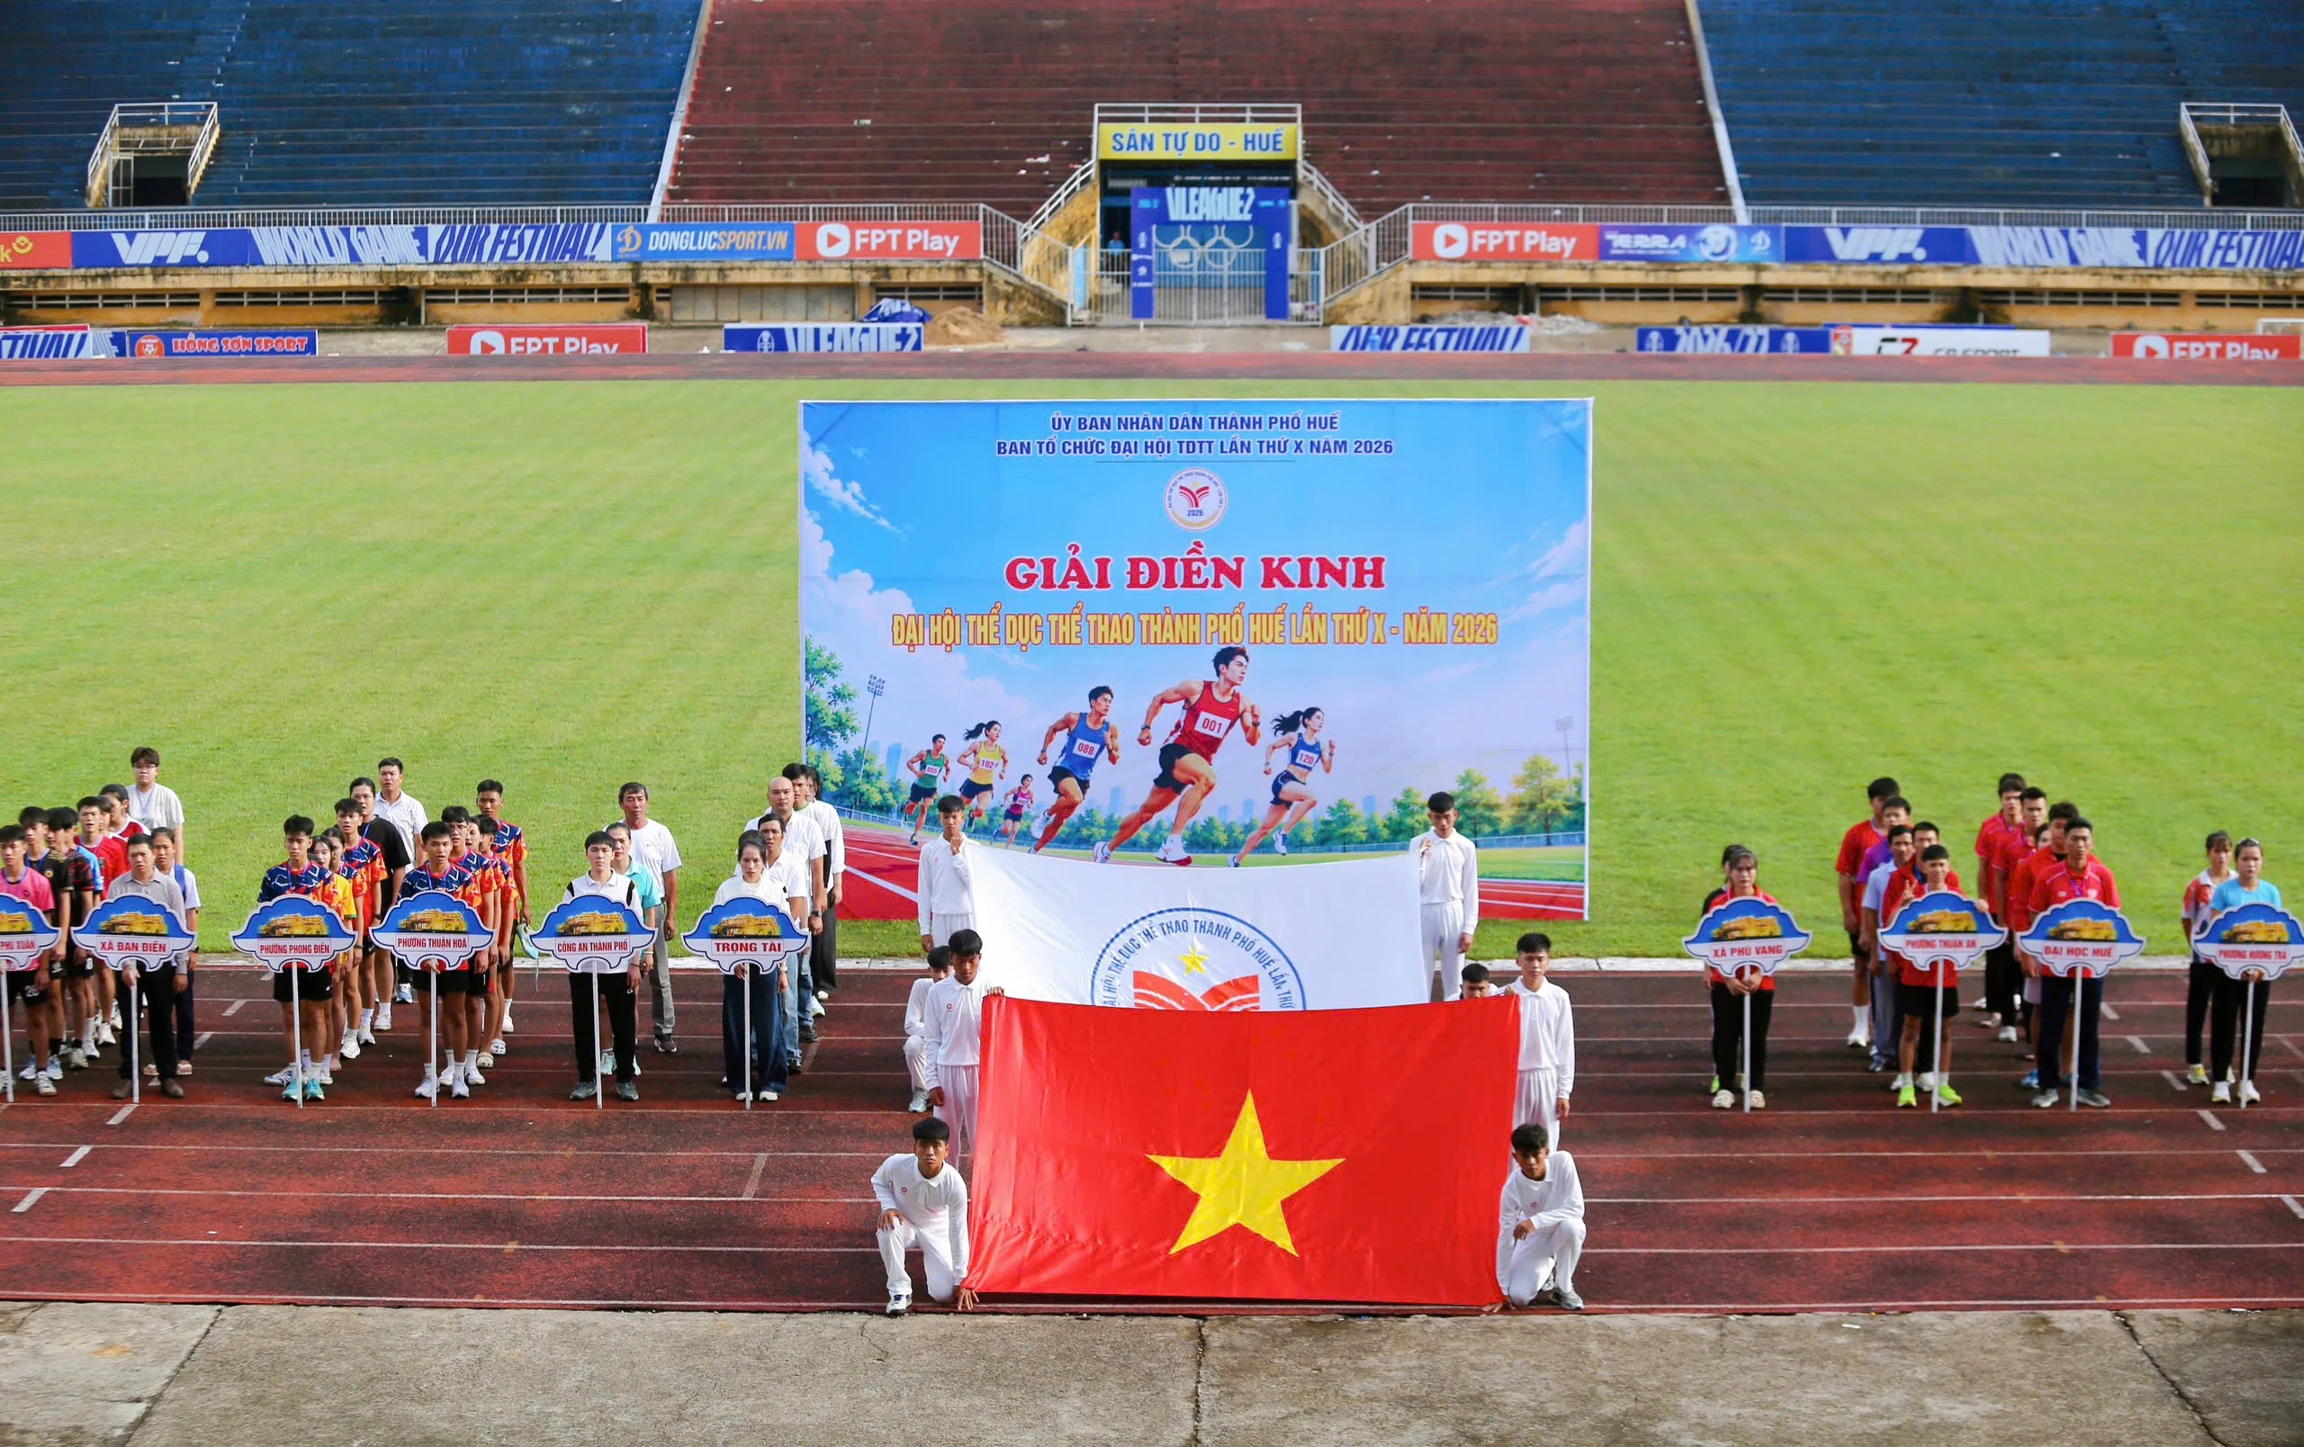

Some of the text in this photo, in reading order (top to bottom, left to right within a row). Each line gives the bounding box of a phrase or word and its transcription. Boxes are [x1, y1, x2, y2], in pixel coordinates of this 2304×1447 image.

[1112, 128, 1154, 152] SÂN
[1162, 131, 1189, 157] TỰ
[1194, 133, 1221, 152] DO
[1244, 127, 1286, 152] HUẾ
[251, 227, 427, 265] WORLD GAME
[433, 223, 606, 263] OUR FESTIVAL!
[648, 230, 788, 250] DONGLUCSPORT.VN
[855, 229, 960, 257] FPT Play
[1472, 230, 1577, 258] FPT Play
[2153, 231, 2304, 269] OUR FESTIVA
[221, 335, 253, 353] SƠN
[254, 336, 308, 353] SPORT
[510, 337, 559, 354] FPT
[2173, 341, 2222, 359] FPT
[1051, 411, 1340, 431] ỦY BAN NHÂN DÂN THÀNH PHỐ HUẾ
[997, 435, 1393, 458] BAN TỔ CHỨC ĐẠI HỘI TDTT LẦN THỨ X NĂM 2026
[1187, 509, 1204, 517] 2026
[1005, 540, 1387, 590] GIẢI ĐIỀN KINH
[892, 601, 1499, 653] ĐẠI HỘI THỂ DỤC THỂ THAO THÀNH PHỐ HUẾ LẦN THỨ X - NĂM 2026
[1201, 718, 1223, 734] 001
[1077, 742, 1095, 756] 088
[981, 759, 995, 770] 102
[1299, 754, 1315, 765] 120
[100, 940, 114, 951] XÃ
[117, 941, 138, 952] ĐAN
[289, 944, 312, 954] PHONG
[398, 936, 427, 948] PHƯỜNG
[428, 936, 451, 950] THUẬN
[557, 938, 628, 953] CÔNG AN THÀNH PHỐ
[715, 941, 781, 954] TRỌNG TÀI
[1159, 920, 1188, 936] THAO
[1194, 918, 1232, 940] THÀNH
[1231, 931, 1260, 952] PHỐ
[1252, 947, 1280, 970] HUẾ
[1755, 944, 1783, 956] VANG
